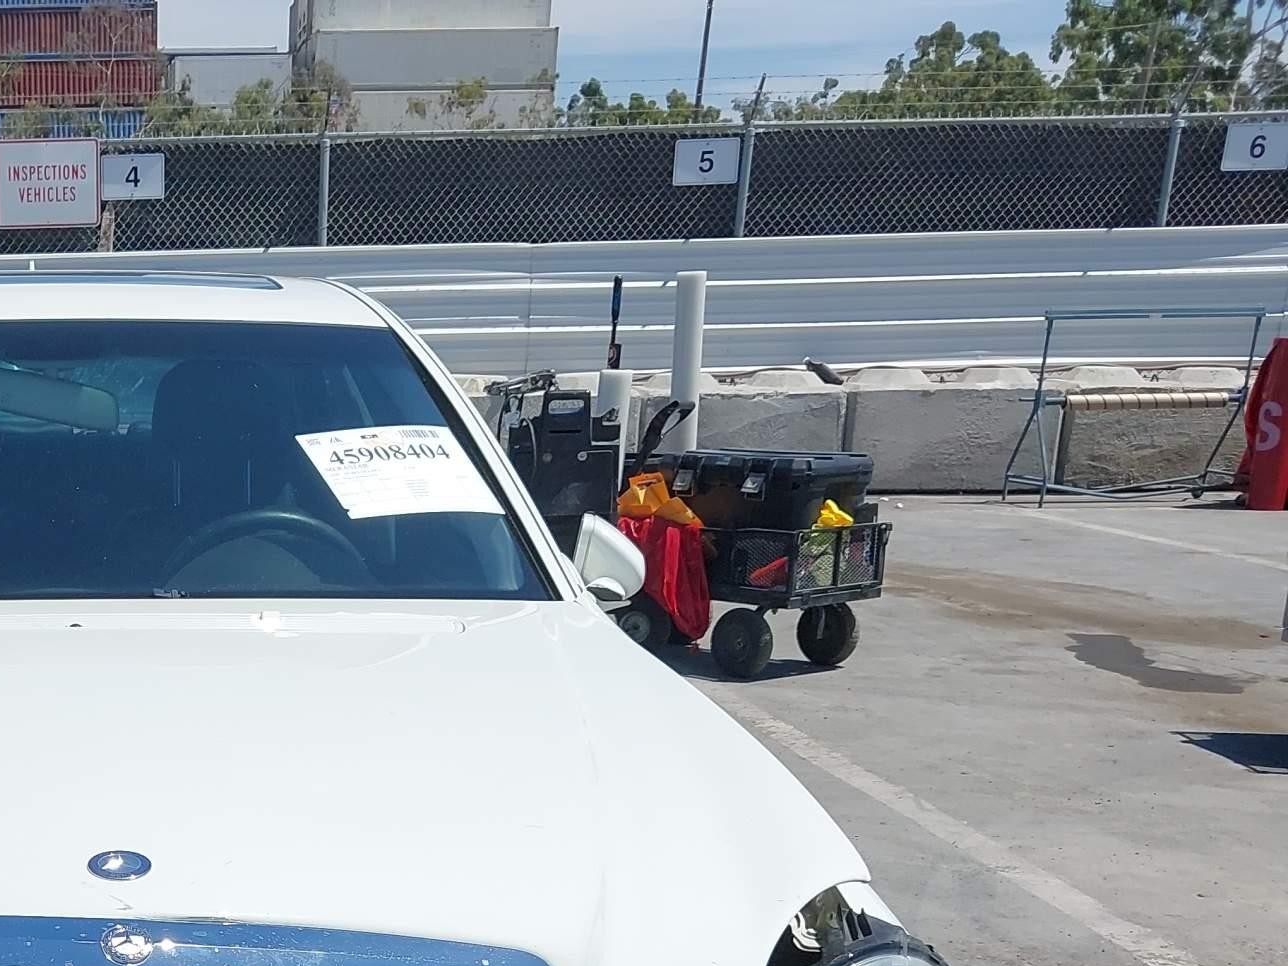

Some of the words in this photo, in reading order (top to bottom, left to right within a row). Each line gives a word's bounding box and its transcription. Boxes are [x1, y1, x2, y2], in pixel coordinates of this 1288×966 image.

[1250, 135, 1267, 159] 6
[698, 150, 714, 173] 5
[8, 164, 87, 182] INSPECTIONS
[125, 166, 141, 188] 4
[18, 186, 77, 203] VEHICLES
[329, 443, 450, 466] 45908404
